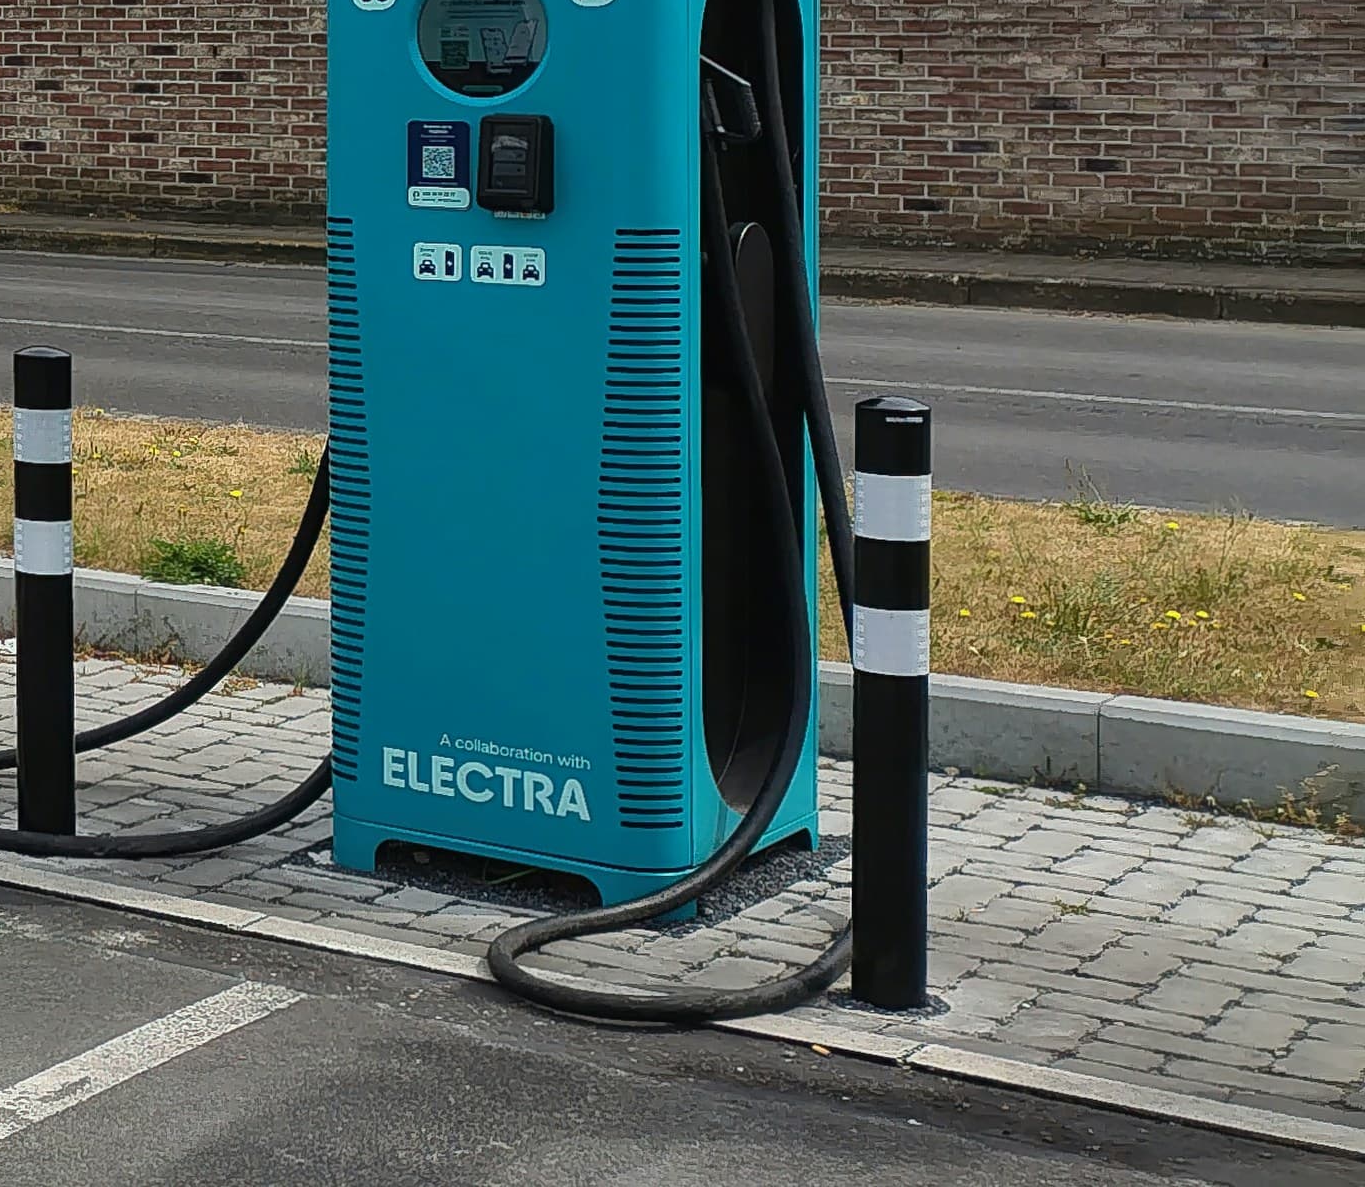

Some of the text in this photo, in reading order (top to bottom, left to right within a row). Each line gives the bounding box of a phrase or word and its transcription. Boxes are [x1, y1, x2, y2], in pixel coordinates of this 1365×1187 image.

[439, 733, 591, 770] A collaboration with
[383, 747, 591, 821] ELECTRA
